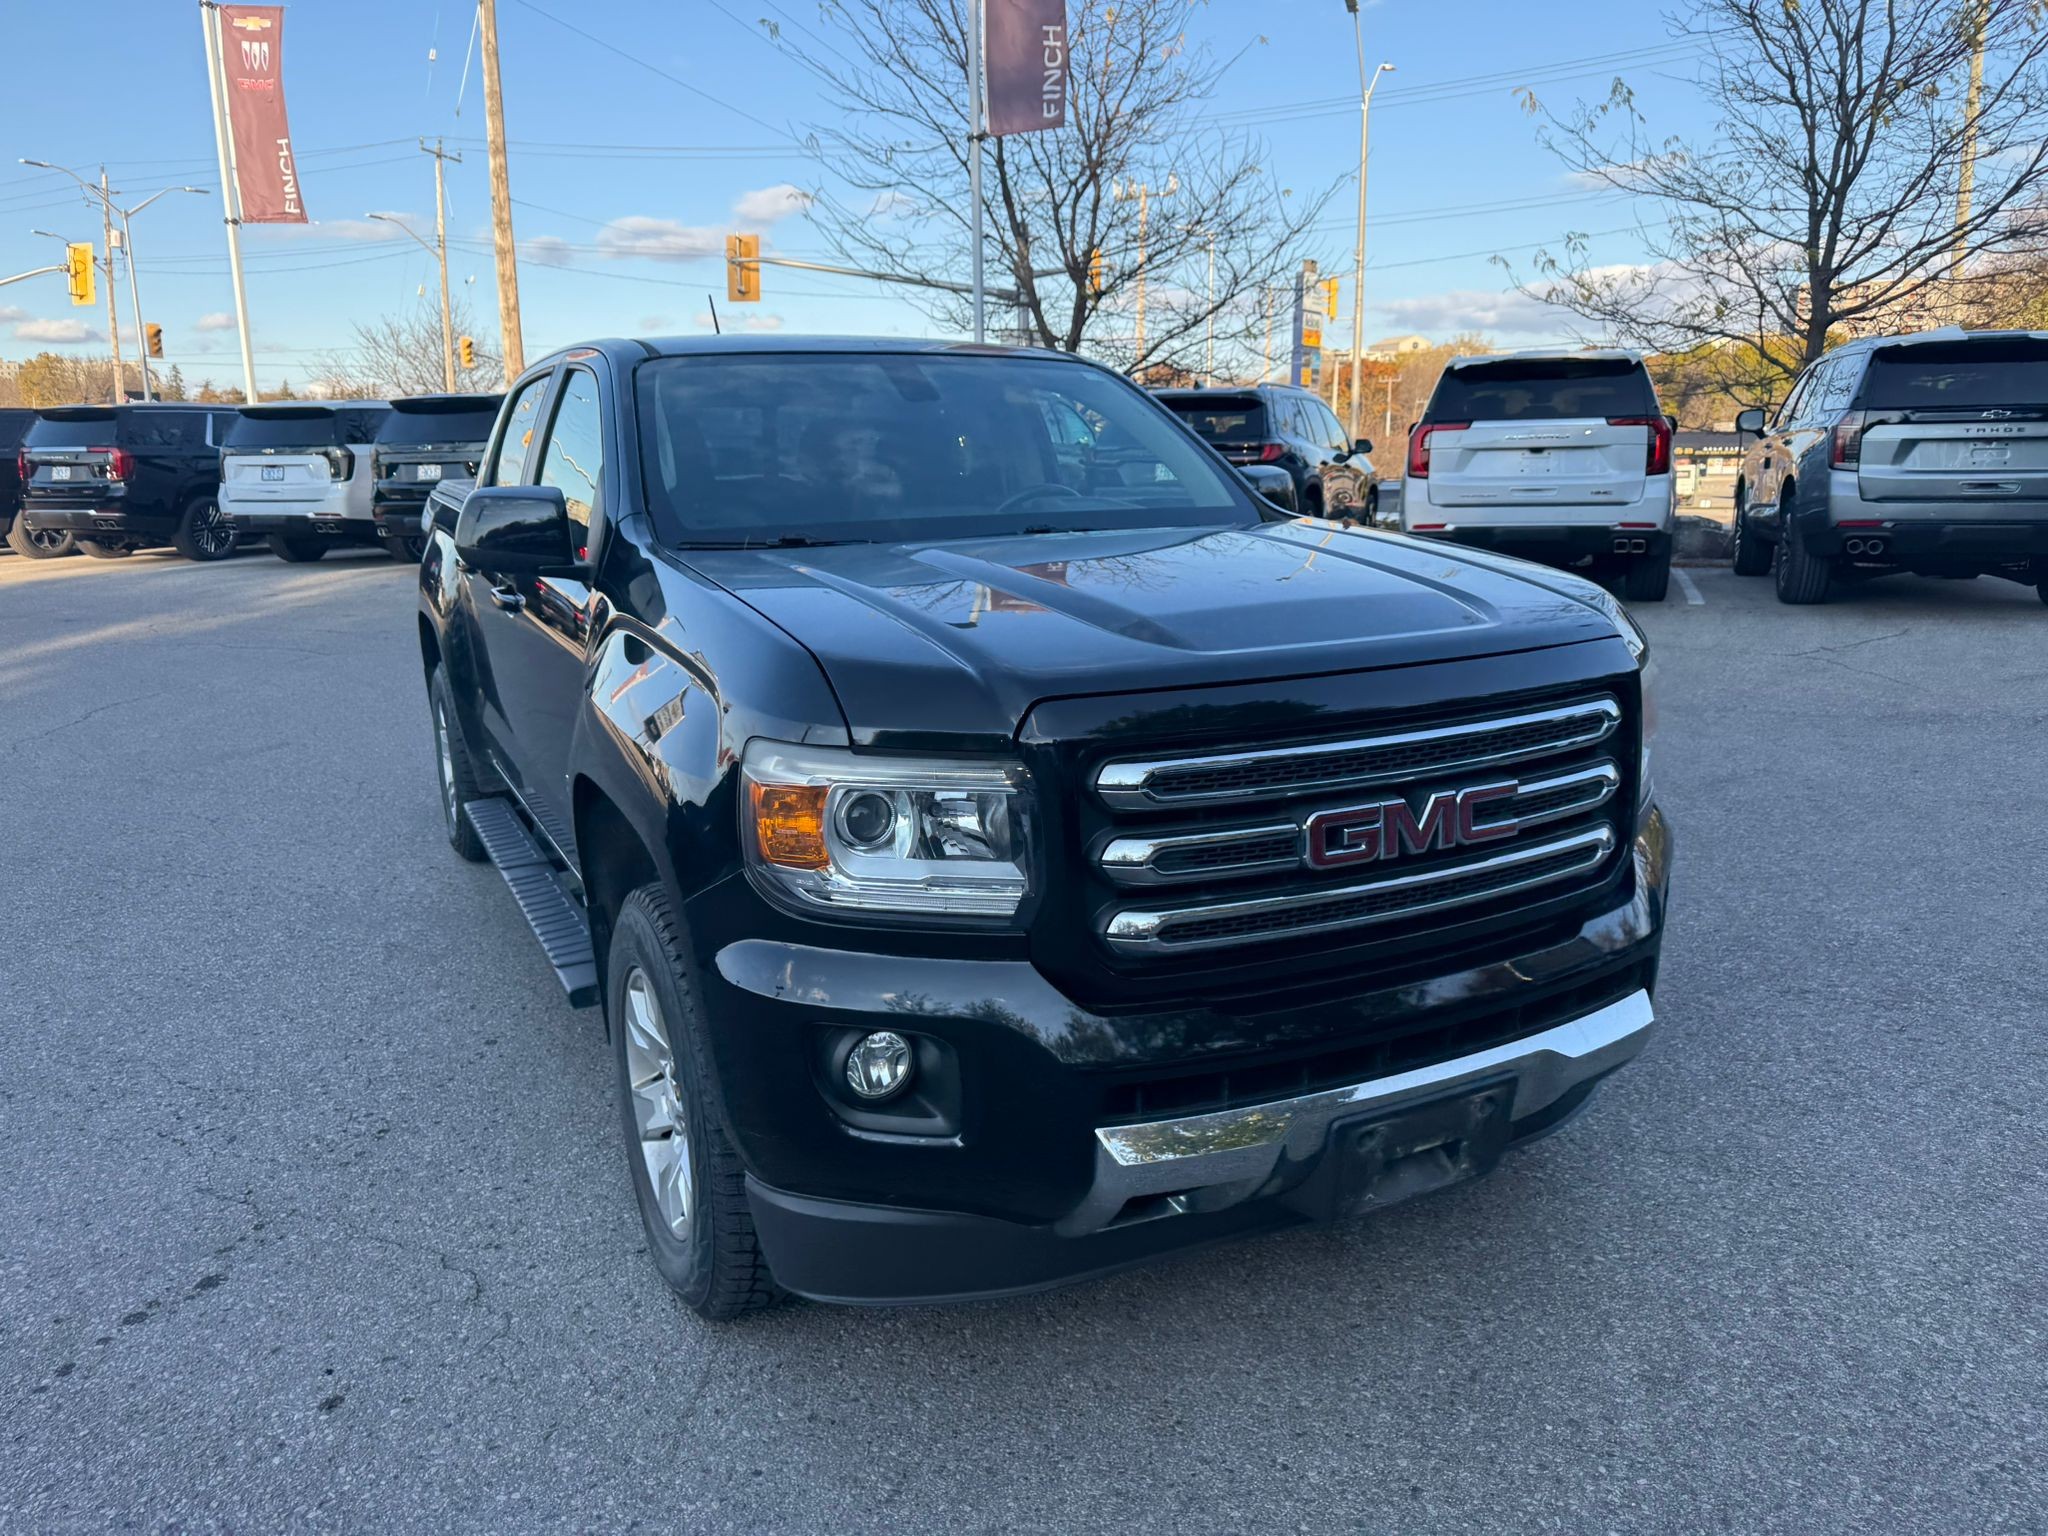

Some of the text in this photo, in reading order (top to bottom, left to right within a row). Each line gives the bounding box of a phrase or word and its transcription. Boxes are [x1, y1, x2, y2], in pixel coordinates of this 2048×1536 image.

[237, 78, 274, 90] GMC
[1042, 25, 1062, 118] FINCH
[276, 138, 300, 214] FINCH
[1963, 426, 2027, 434] TAHOE
[1305, 779, 1519, 871] GMC
